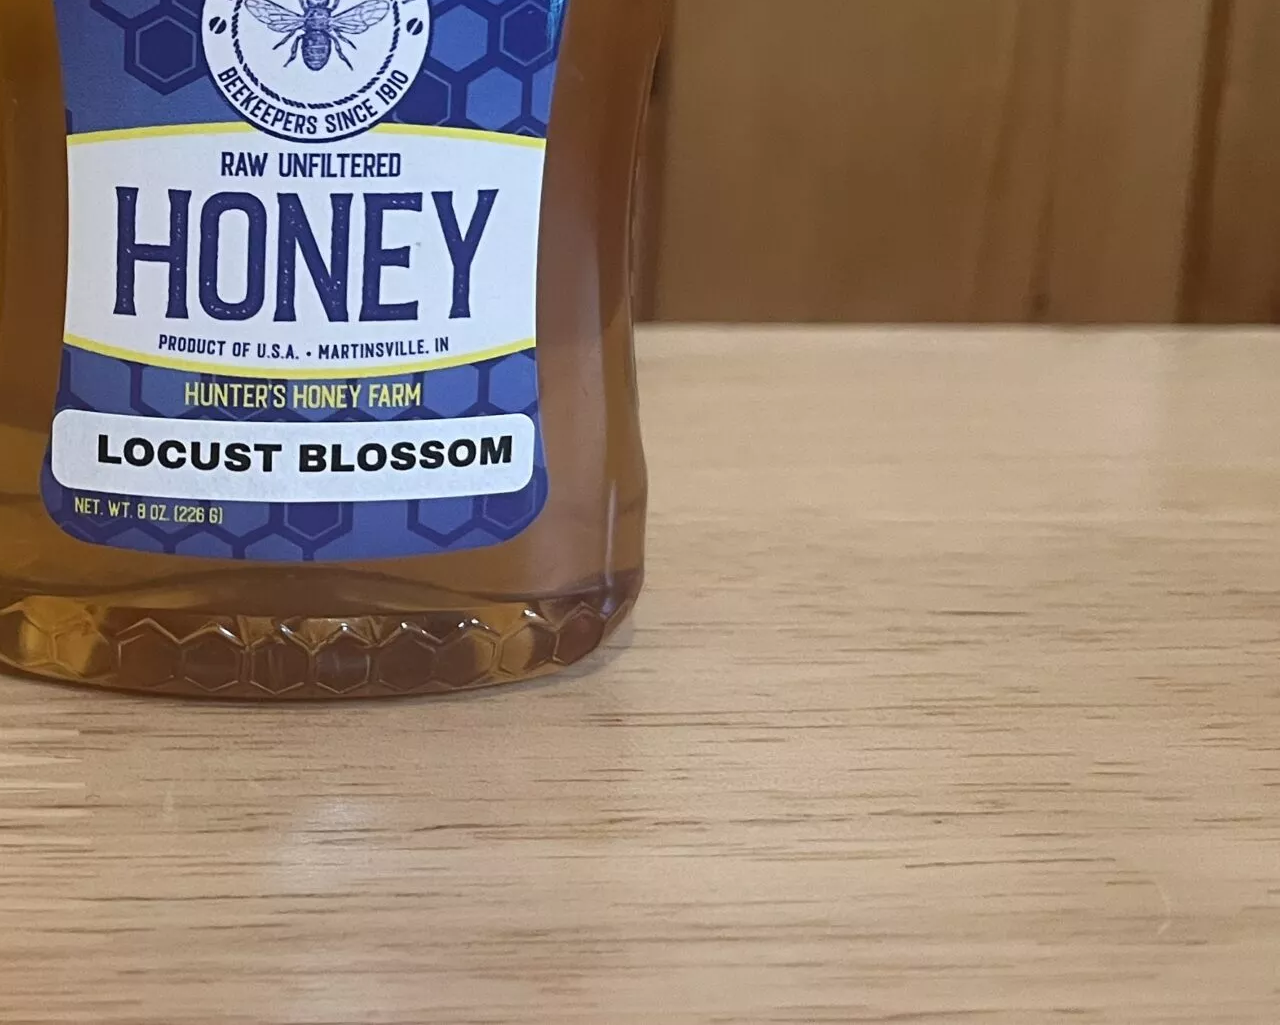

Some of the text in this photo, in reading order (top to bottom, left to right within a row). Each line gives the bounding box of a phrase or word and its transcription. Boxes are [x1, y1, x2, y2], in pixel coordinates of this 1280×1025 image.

[218, 66, 408, 134] BEEKEEPERS SINCE 1910
[221, 152, 401, 178] RAW UNFILTERED
[113, 187, 500, 322] HONEY
[158, 334, 226, 355] PRODUCT
[232, 341, 250, 357] OF
[257, 342, 299, 359] U.S.A.
[434, 336, 449, 352] IN
[185, 381, 421, 408] HUNTER'S HONEY FARM
[97, 434, 513, 472] LOCUST BLOSSOM
[74, 496, 223, 524] NET. WT. 8 OZ. (226 G)
